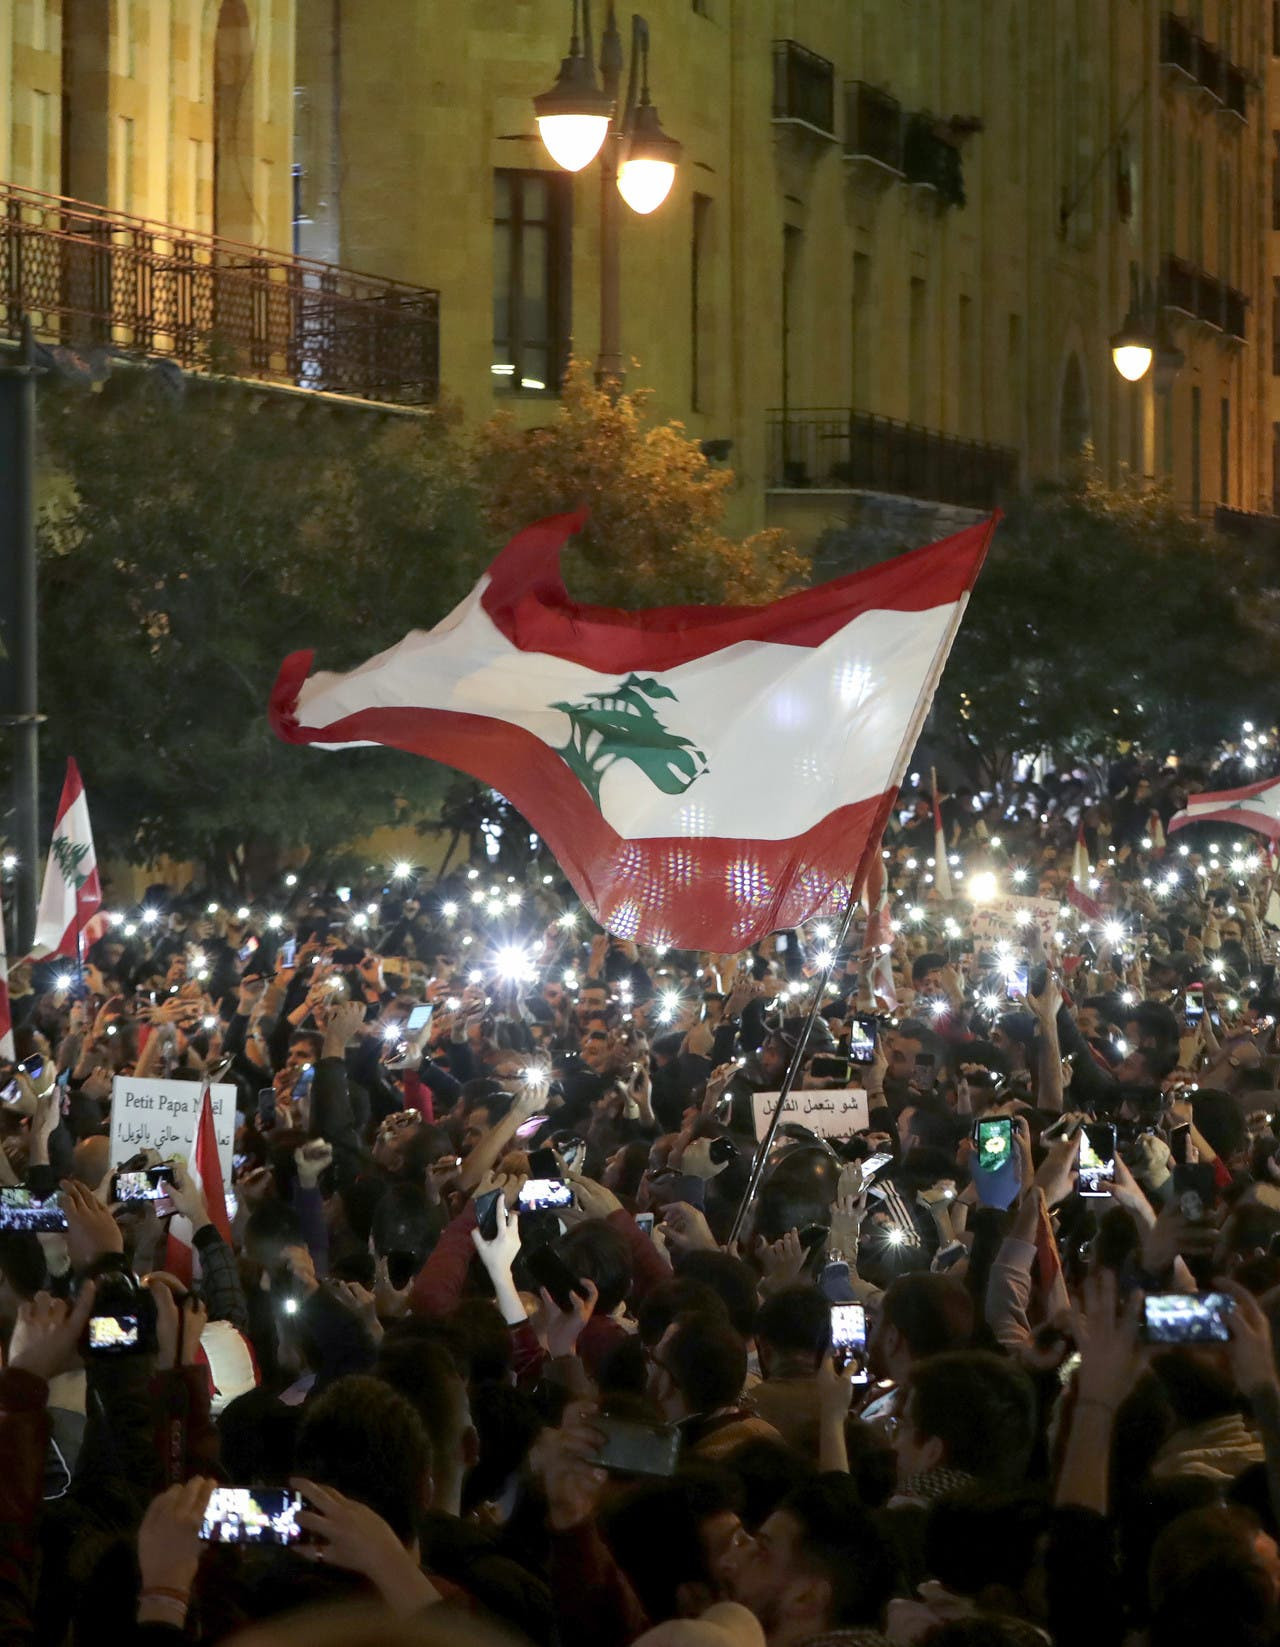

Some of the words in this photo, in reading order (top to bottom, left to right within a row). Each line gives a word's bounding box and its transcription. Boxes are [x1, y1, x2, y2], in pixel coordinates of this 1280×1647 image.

[125, 1092, 153, 1110] Petit
[158, 1095, 188, 1117] Papa
[193, 1098, 223, 1115] Nël
[803, 1098, 835, 1114] بتعمل
[840, 1096, 859, 1114] شو
[154, 1125, 179, 1150] حالتي
